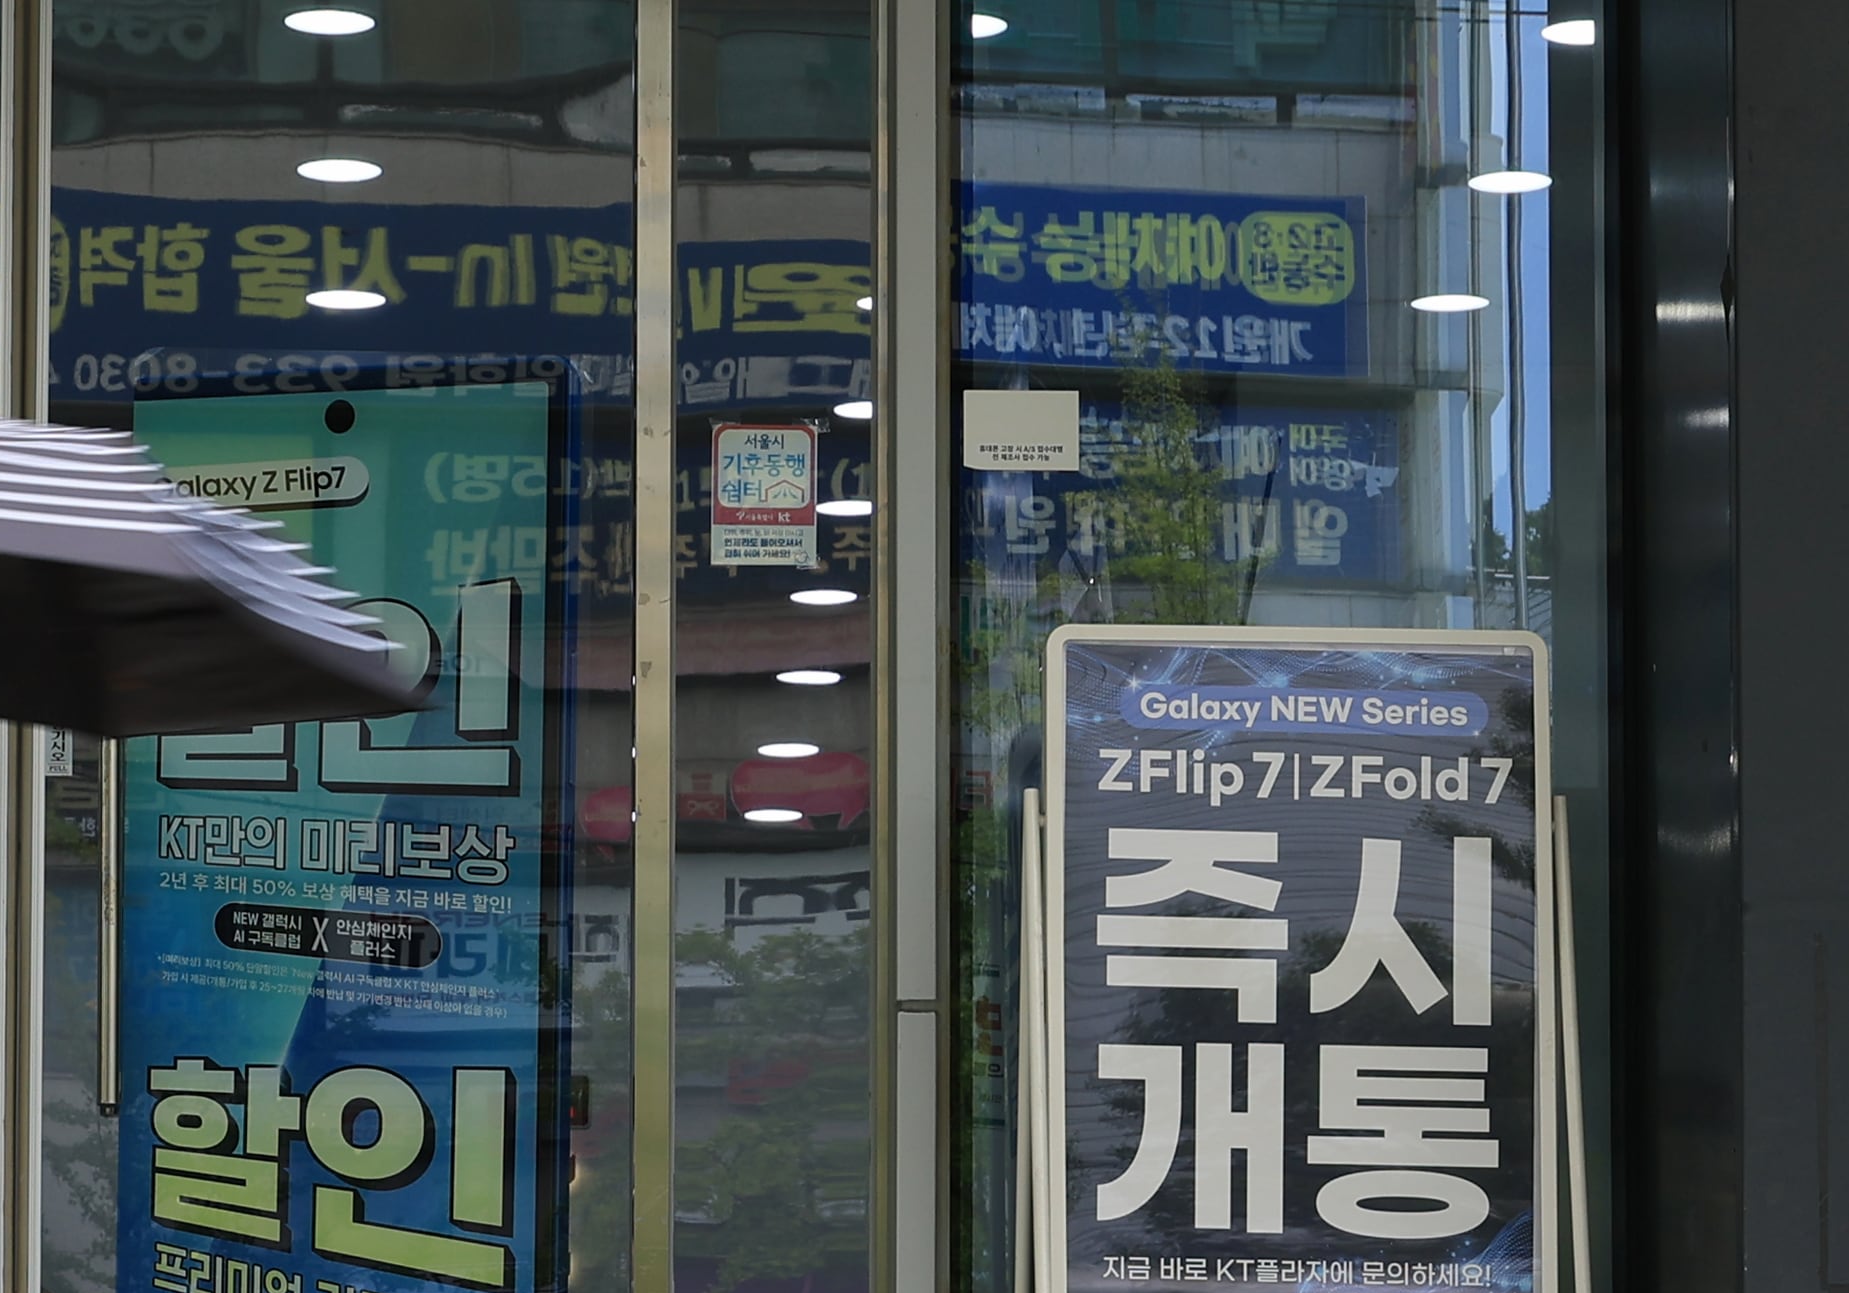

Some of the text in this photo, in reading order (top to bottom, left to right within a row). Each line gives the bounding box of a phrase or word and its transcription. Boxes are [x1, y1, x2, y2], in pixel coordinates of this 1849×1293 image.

[744, 434, 786, 450] 서울시
[262, 470, 279, 494] Z
[284, 465, 347, 499] Flip7
[722, 452, 806, 478] 기후동행
[778, 512, 791, 523] kt
[1139, 691, 1470, 728] Galaxy NEW Series
[49, 726, 68, 762] 기시오
[158, 814, 516, 885] KT만의 미리보상
[159, 871, 512, 914] 2년 후 최대 50% 보상 혜택을 지금 바로 할인!
[232, 911, 303, 931] NEW 갤럭시
[310, 916, 330, 953] X
[335, 919, 413, 942] 안심체인지
[1096, 827, 1493, 1028] 즉시
[233, 930, 302, 951] AI 구독클럽
[349, 938, 396, 959] 플러스
[222, 959, 245, 972] 50%
[403, 978, 418, 991] KT
[1096, 1041, 1501, 1240] 개통
[149, 1056, 515, 1293] 할인
[1103, 1255, 1493, 1290] 지금 바로 KT플라자에 문의하세요!
